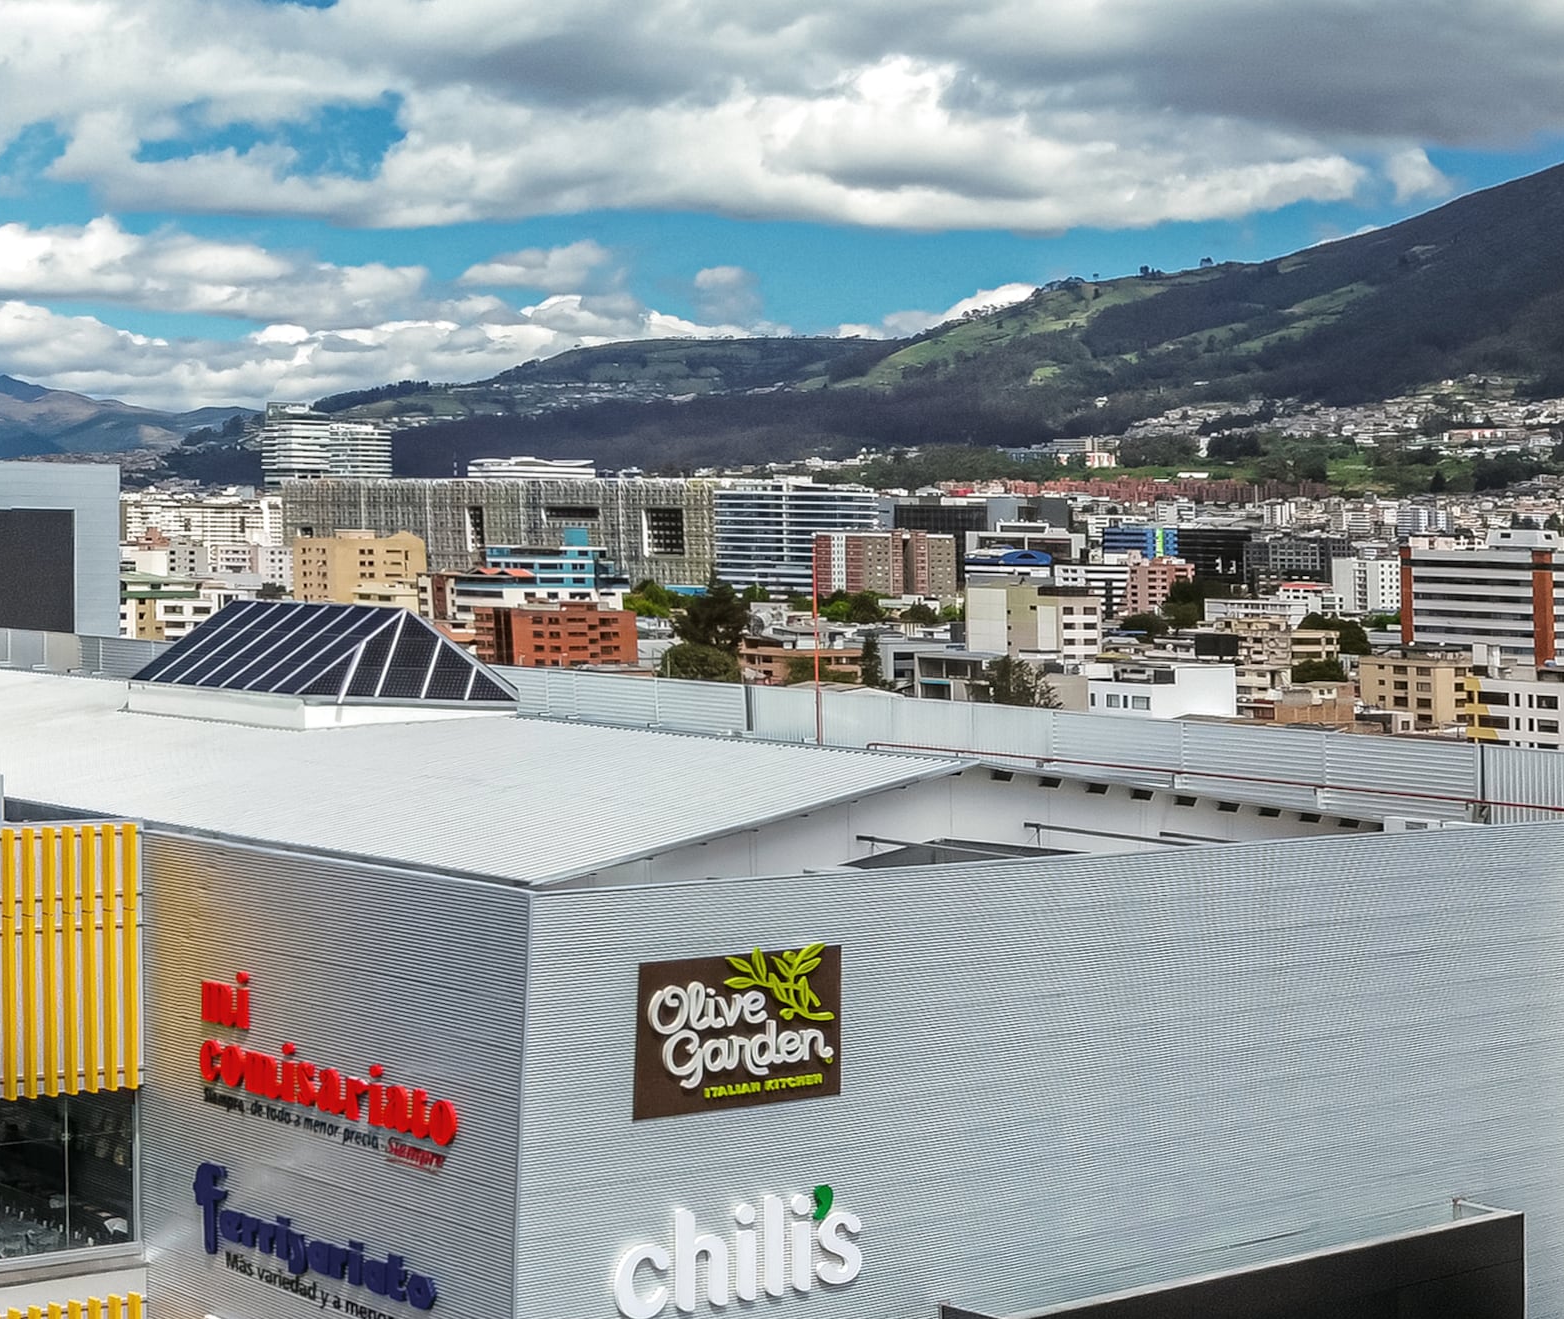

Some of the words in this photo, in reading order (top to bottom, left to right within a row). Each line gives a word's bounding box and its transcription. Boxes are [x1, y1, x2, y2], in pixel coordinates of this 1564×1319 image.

[201, 971, 250, 1030] mi
[647, 981, 768, 1035] Olive
[662, 1019, 834, 1089] Garden
[703, 1081, 761, 1099] ITALIAN
[764, 1073, 823, 1091] KITCHEN
[250, 1101, 264, 1116] de
[266, 1105, 291, 1124] todo
[293, 1115, 302, 1127] a
[303, 1117, 339, 1138] menor
[225, 1250, 254, 1276] Más
[257, 1269, 317, 1301] variedad
[319, 1290, 329, 1309] y
[332, 1295, 342, 1310] a
